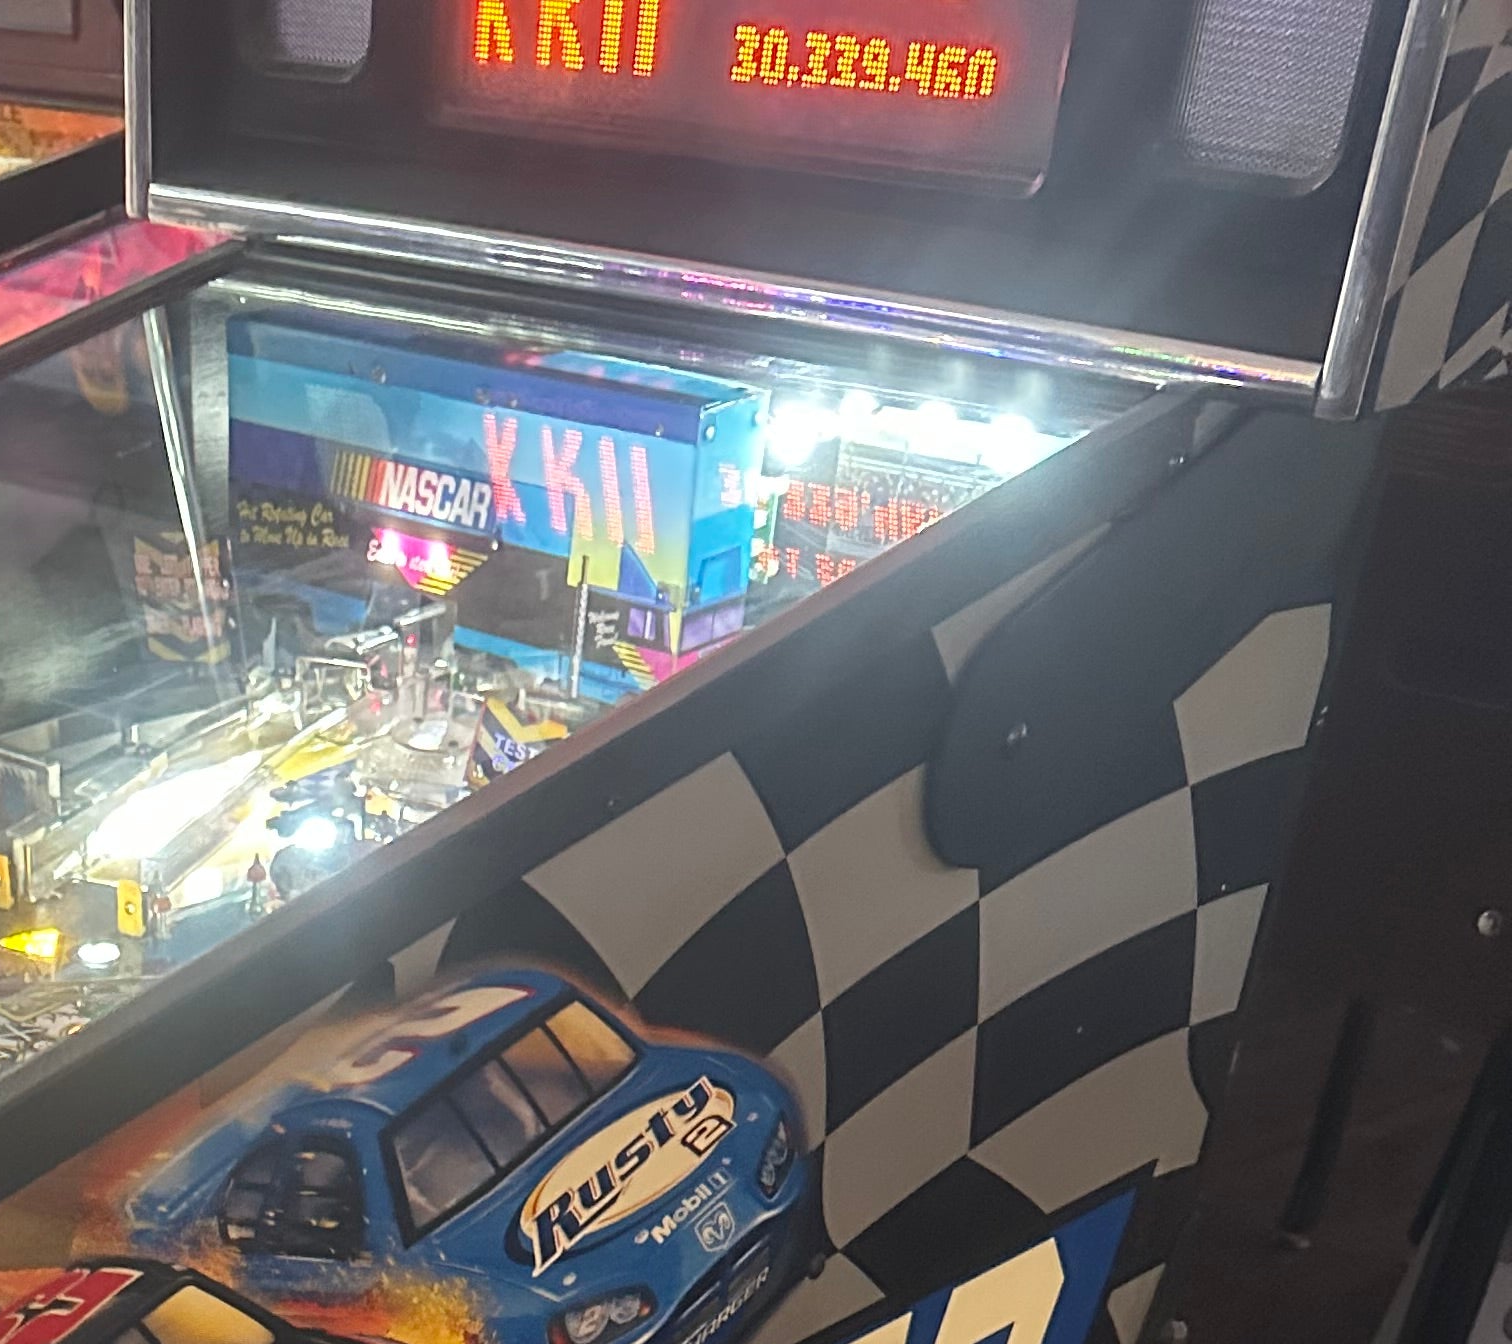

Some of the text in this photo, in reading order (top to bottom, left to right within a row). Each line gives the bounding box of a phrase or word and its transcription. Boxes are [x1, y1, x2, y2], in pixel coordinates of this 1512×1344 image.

[378, 461, 491, 530] NASCAR
[682, 1114, 736, 1157] 2
[531, 1075, 716, 1278] Rusty
[646, 1183, 711, 1244] Mobil
